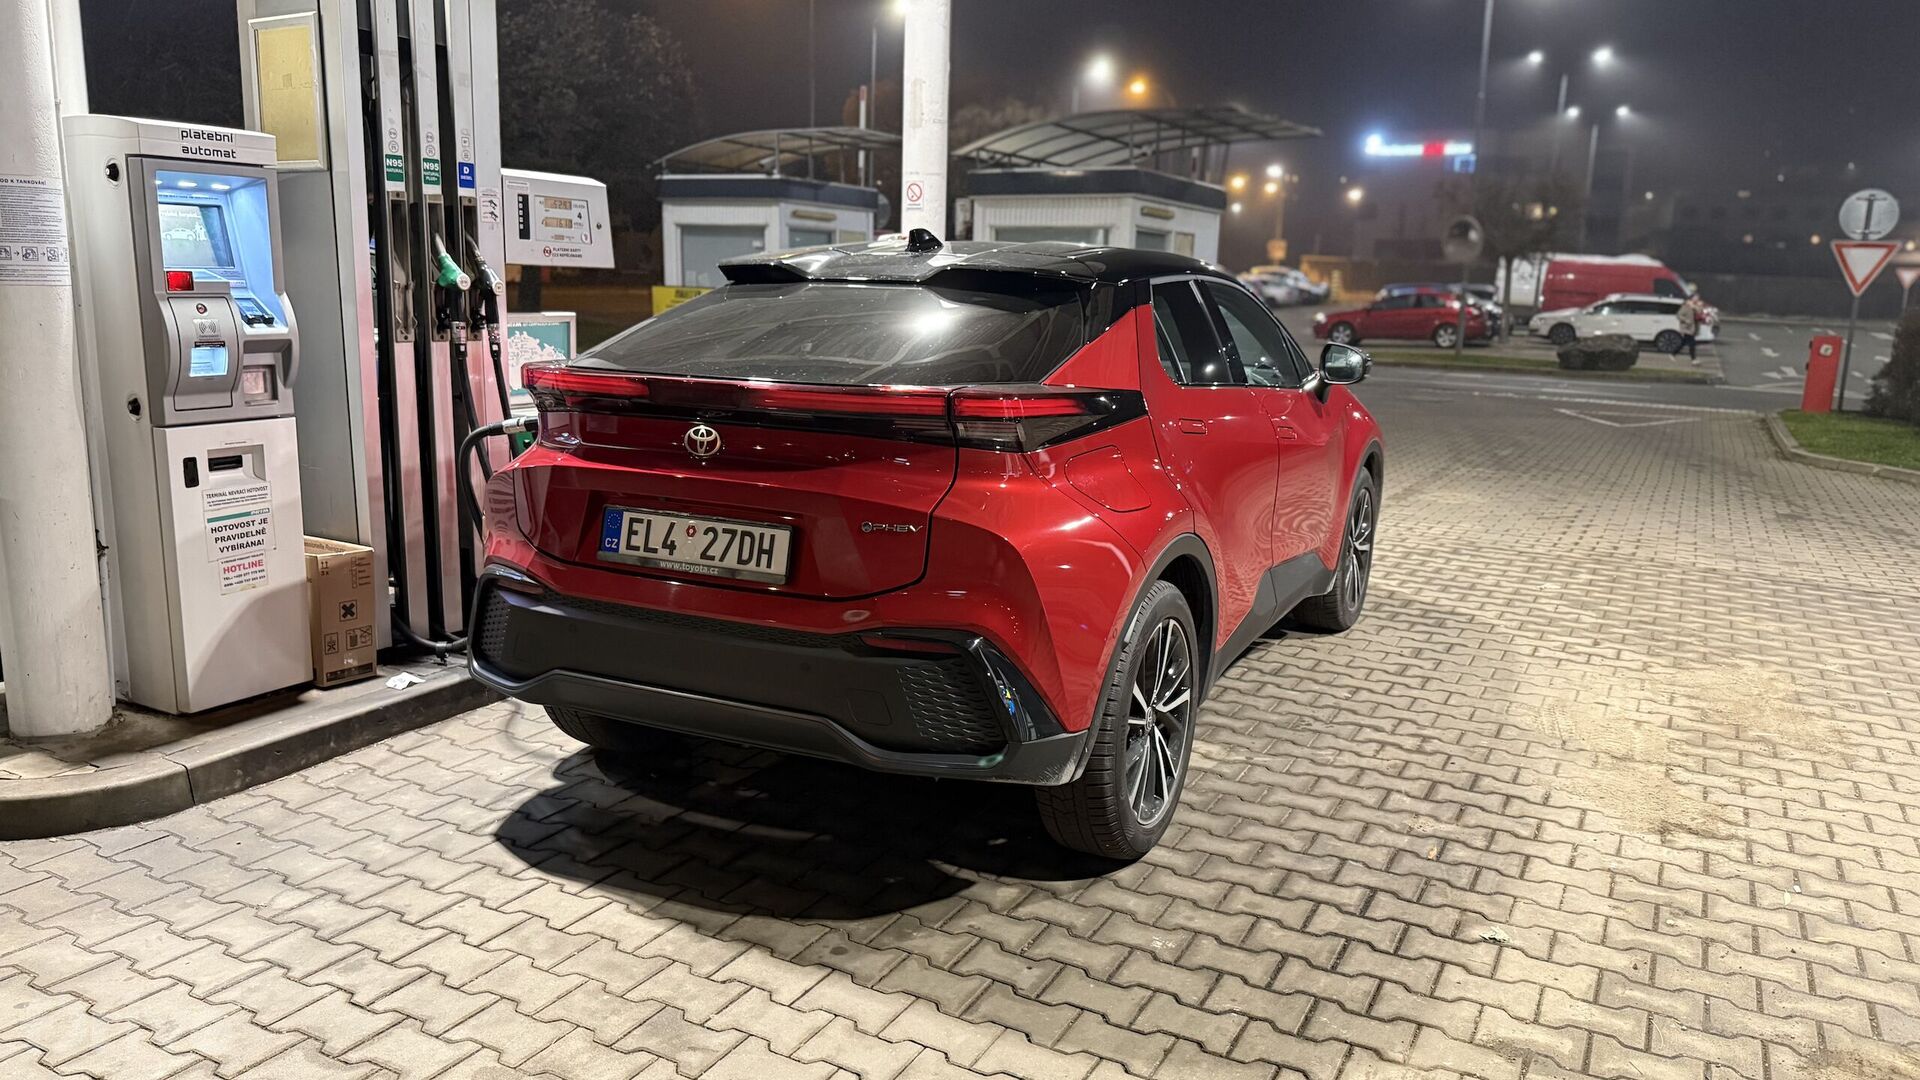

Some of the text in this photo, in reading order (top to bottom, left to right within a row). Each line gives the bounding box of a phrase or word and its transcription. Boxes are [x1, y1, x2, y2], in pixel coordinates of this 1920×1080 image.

[181, 146, 237, 159] automat
[386, 159, 403, 167] N95
[423, 162, 440, 171] N95
[463, 166, 470, 174] D
[577, 212, 582, 220] 4
[211, 519, 256, 534] HOTOVOST
[873, 523, 923, 533] PHEV
[214, 527, 267, 544] PRAVIDELNĚ
[219, 538, 265, 553] VYBÍRÁNA!
[605, 537, 618, 549] CZ
[625, 517, 775, 569] EL4 27DH
[223, 559, 264, 574] HOTLINE
[660, 560, 719, 575] www.toyota.cz
